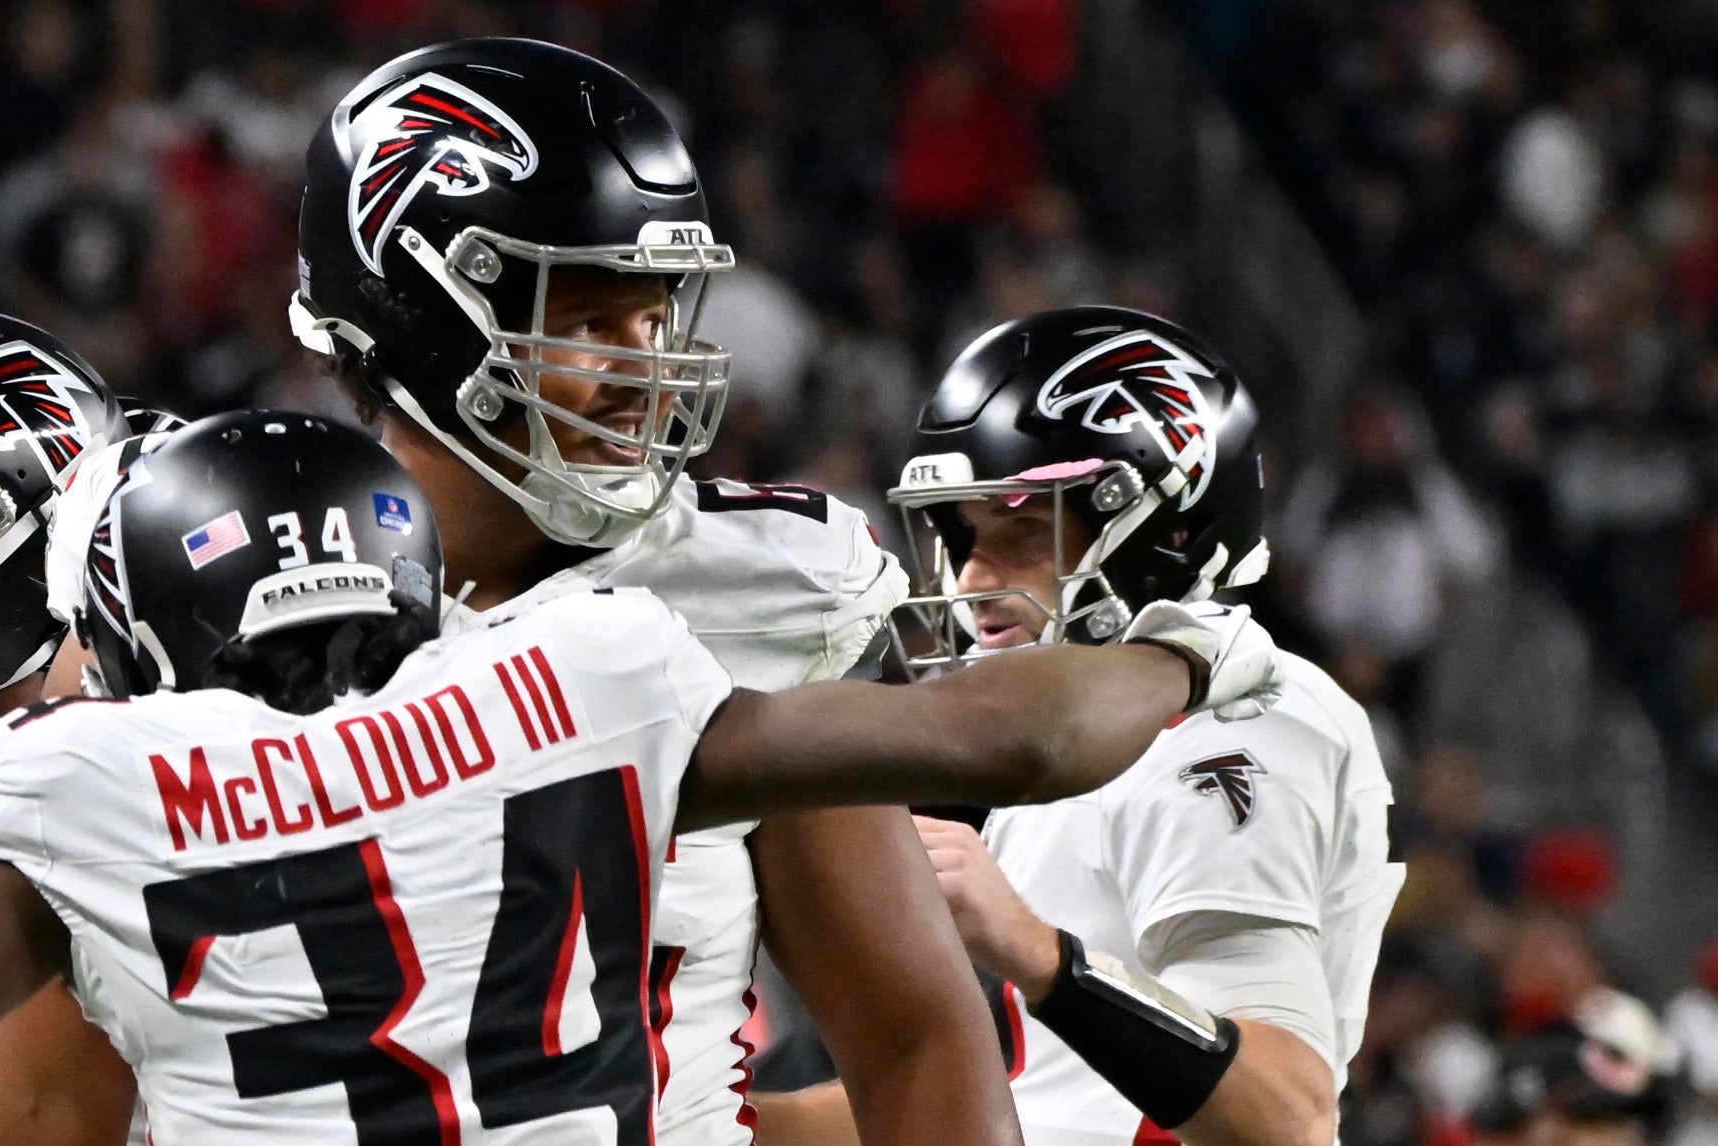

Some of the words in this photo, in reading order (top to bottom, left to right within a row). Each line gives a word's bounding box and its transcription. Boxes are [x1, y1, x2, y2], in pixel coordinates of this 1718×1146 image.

[670, 228, 706, 244] ATL
[909, 465, 942, 482] ATL
[267, 507, 358, 571] 34
[262, 576, 385, 605] FALCONS
[148, 684, 495, 852] McCLOUD
[492, 645, 577, 751] III
